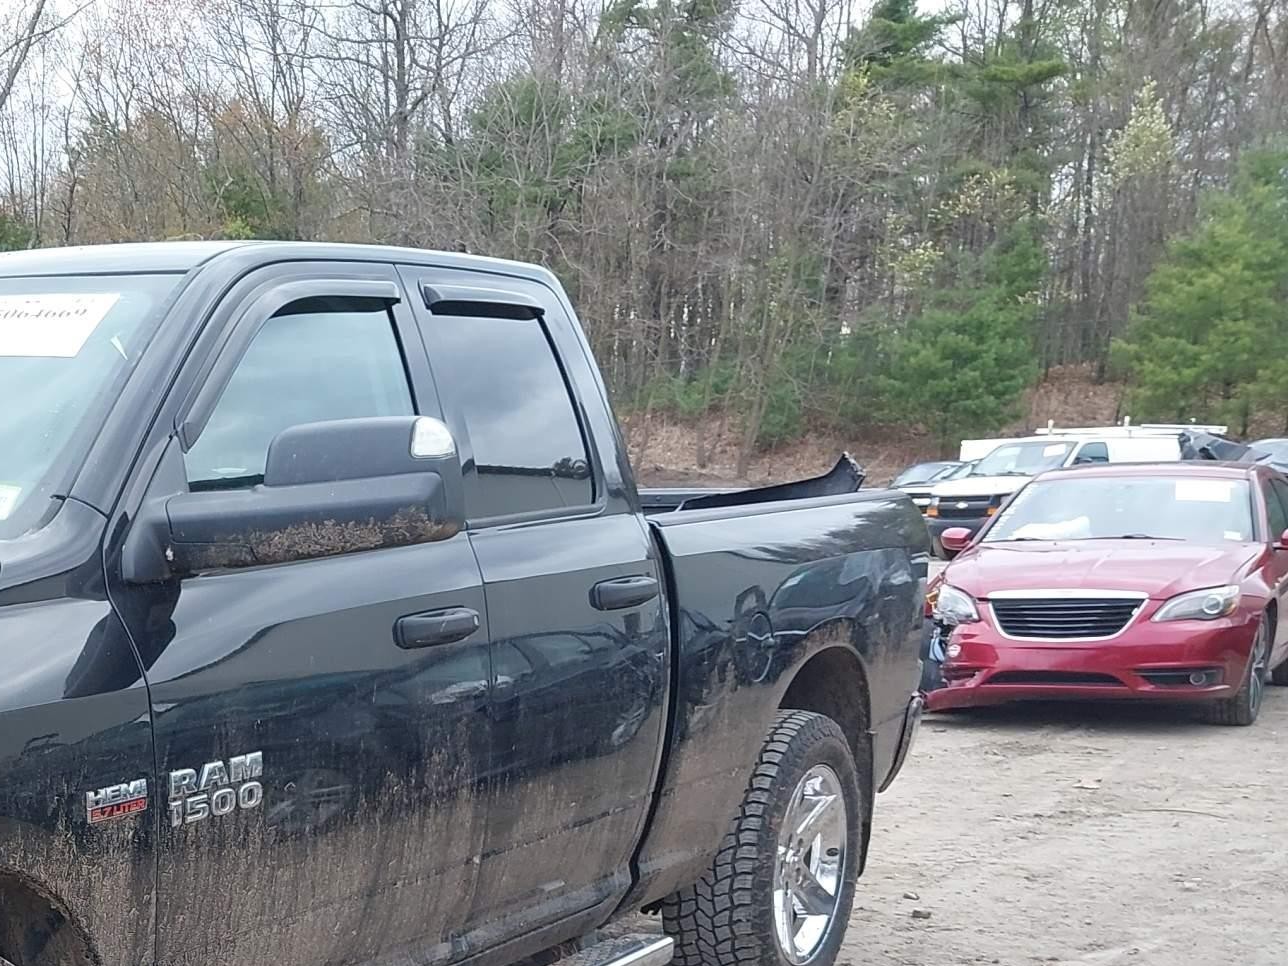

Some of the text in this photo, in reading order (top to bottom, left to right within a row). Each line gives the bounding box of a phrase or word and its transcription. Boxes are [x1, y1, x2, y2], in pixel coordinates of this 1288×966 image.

[85, 778, 148, 809] HEMI
[168, 750, 263, 798] RAM
[91, 799, 146, 821] 5.7 LITER
[168, 780, 263, 828] 1500
